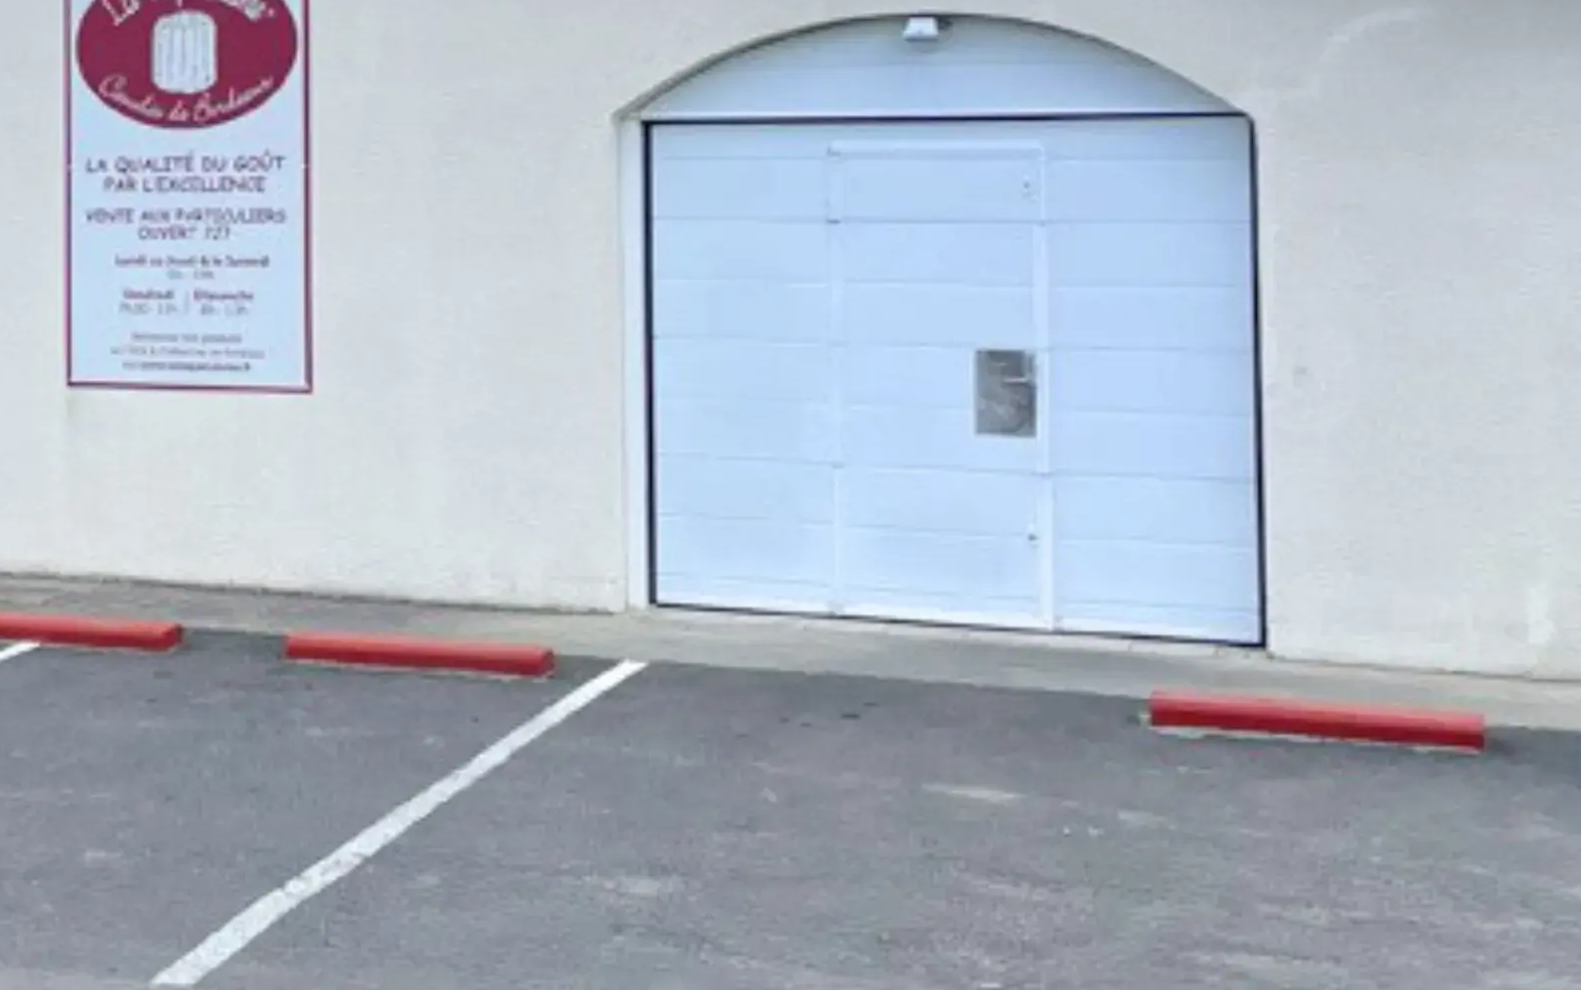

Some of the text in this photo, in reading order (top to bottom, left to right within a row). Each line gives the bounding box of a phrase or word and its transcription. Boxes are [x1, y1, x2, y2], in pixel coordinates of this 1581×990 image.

[85, 147, 286, 173] LA QUALITÉ DU GOÛT
[103, 176, 139, 192] PAR
[85, 208, 135, 224] VENTE
[137, 225, 198, 240] OUVERT
